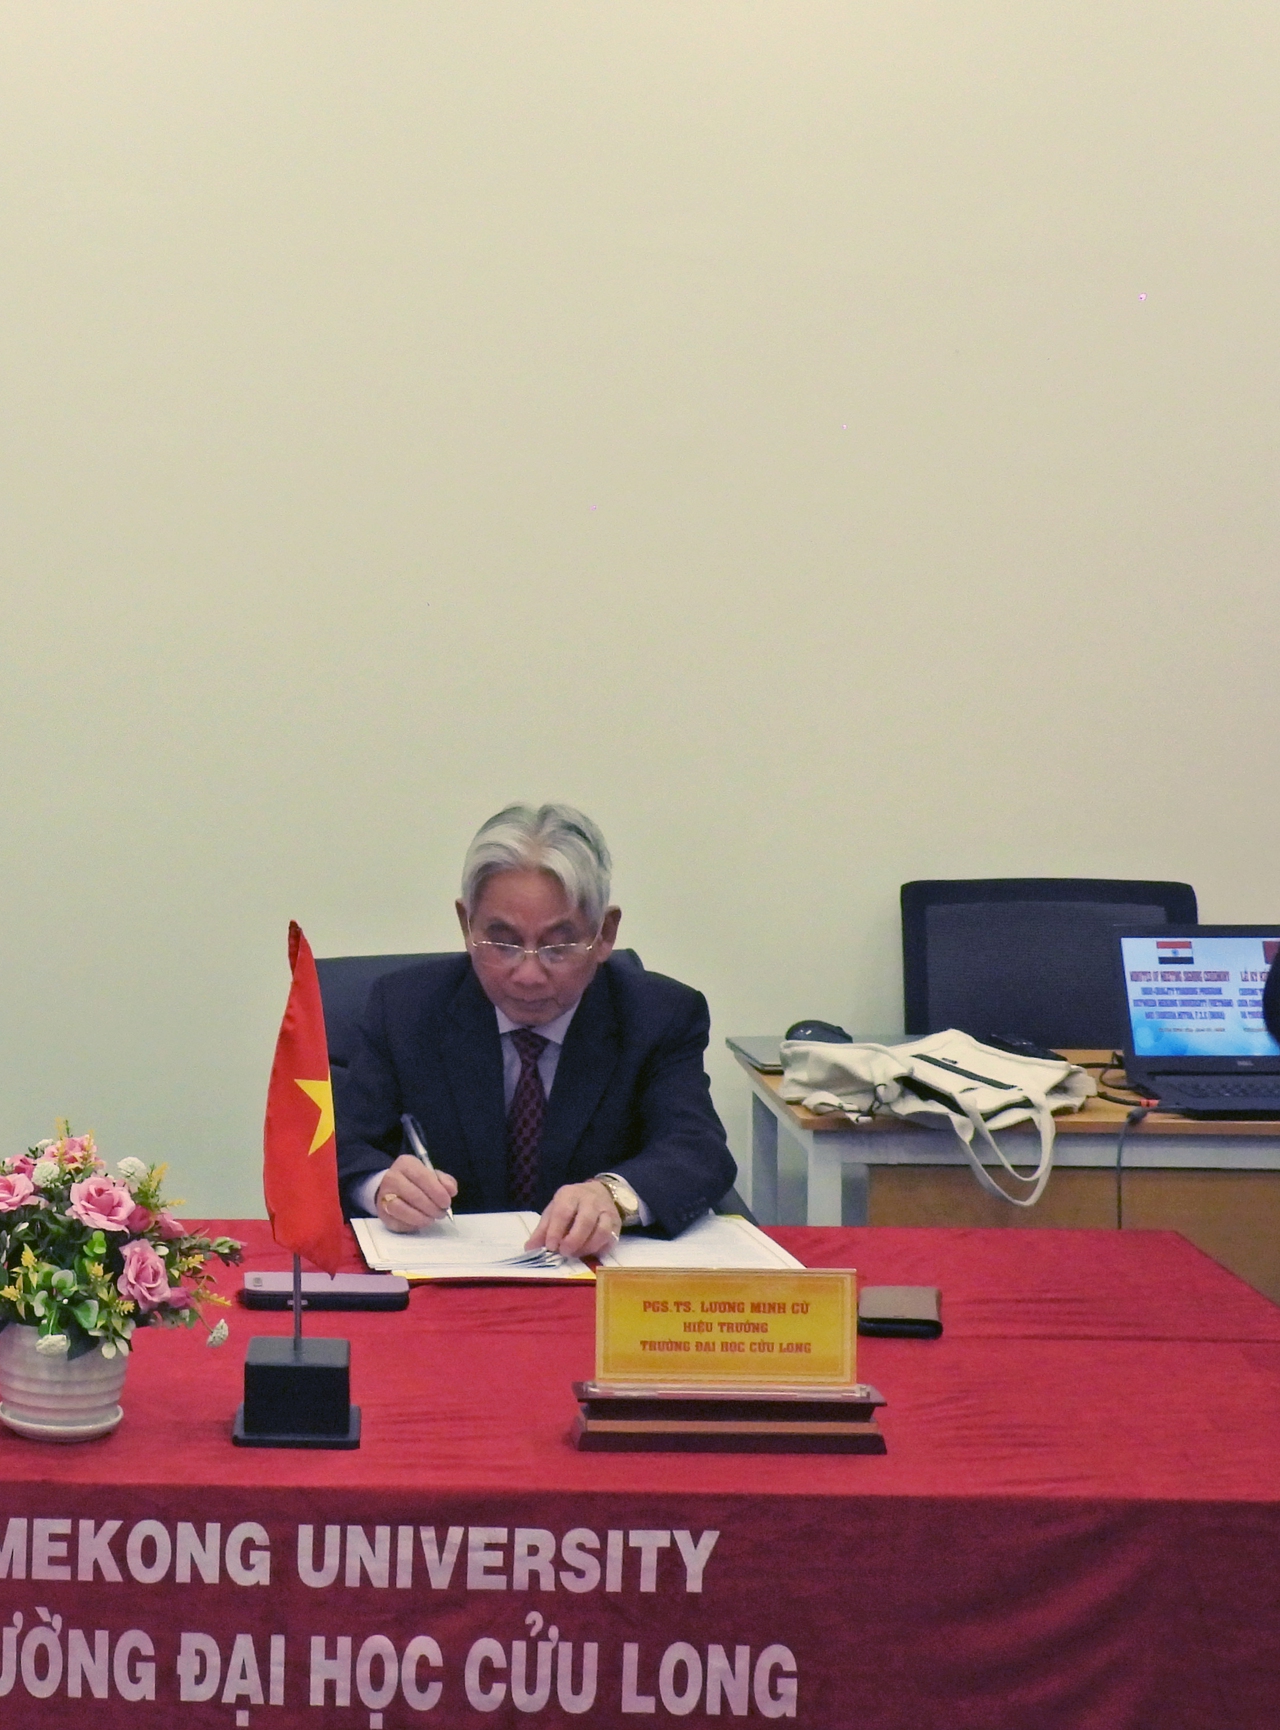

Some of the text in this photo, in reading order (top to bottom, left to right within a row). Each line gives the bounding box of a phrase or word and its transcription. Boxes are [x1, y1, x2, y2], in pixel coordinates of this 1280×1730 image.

[750, 1302, 786, 1314] MINH
[779, 1342, 811, 1354] LONG
[297, 1523, 720, 1593] UNIVERSITY
[177, 1632, 285, 1728] ĐẠI
[310, 1635, 442, 1730] HỌC
[465, 1611, 599, 1716] CỬU
[622, 1641, 798, 1718] LONG
